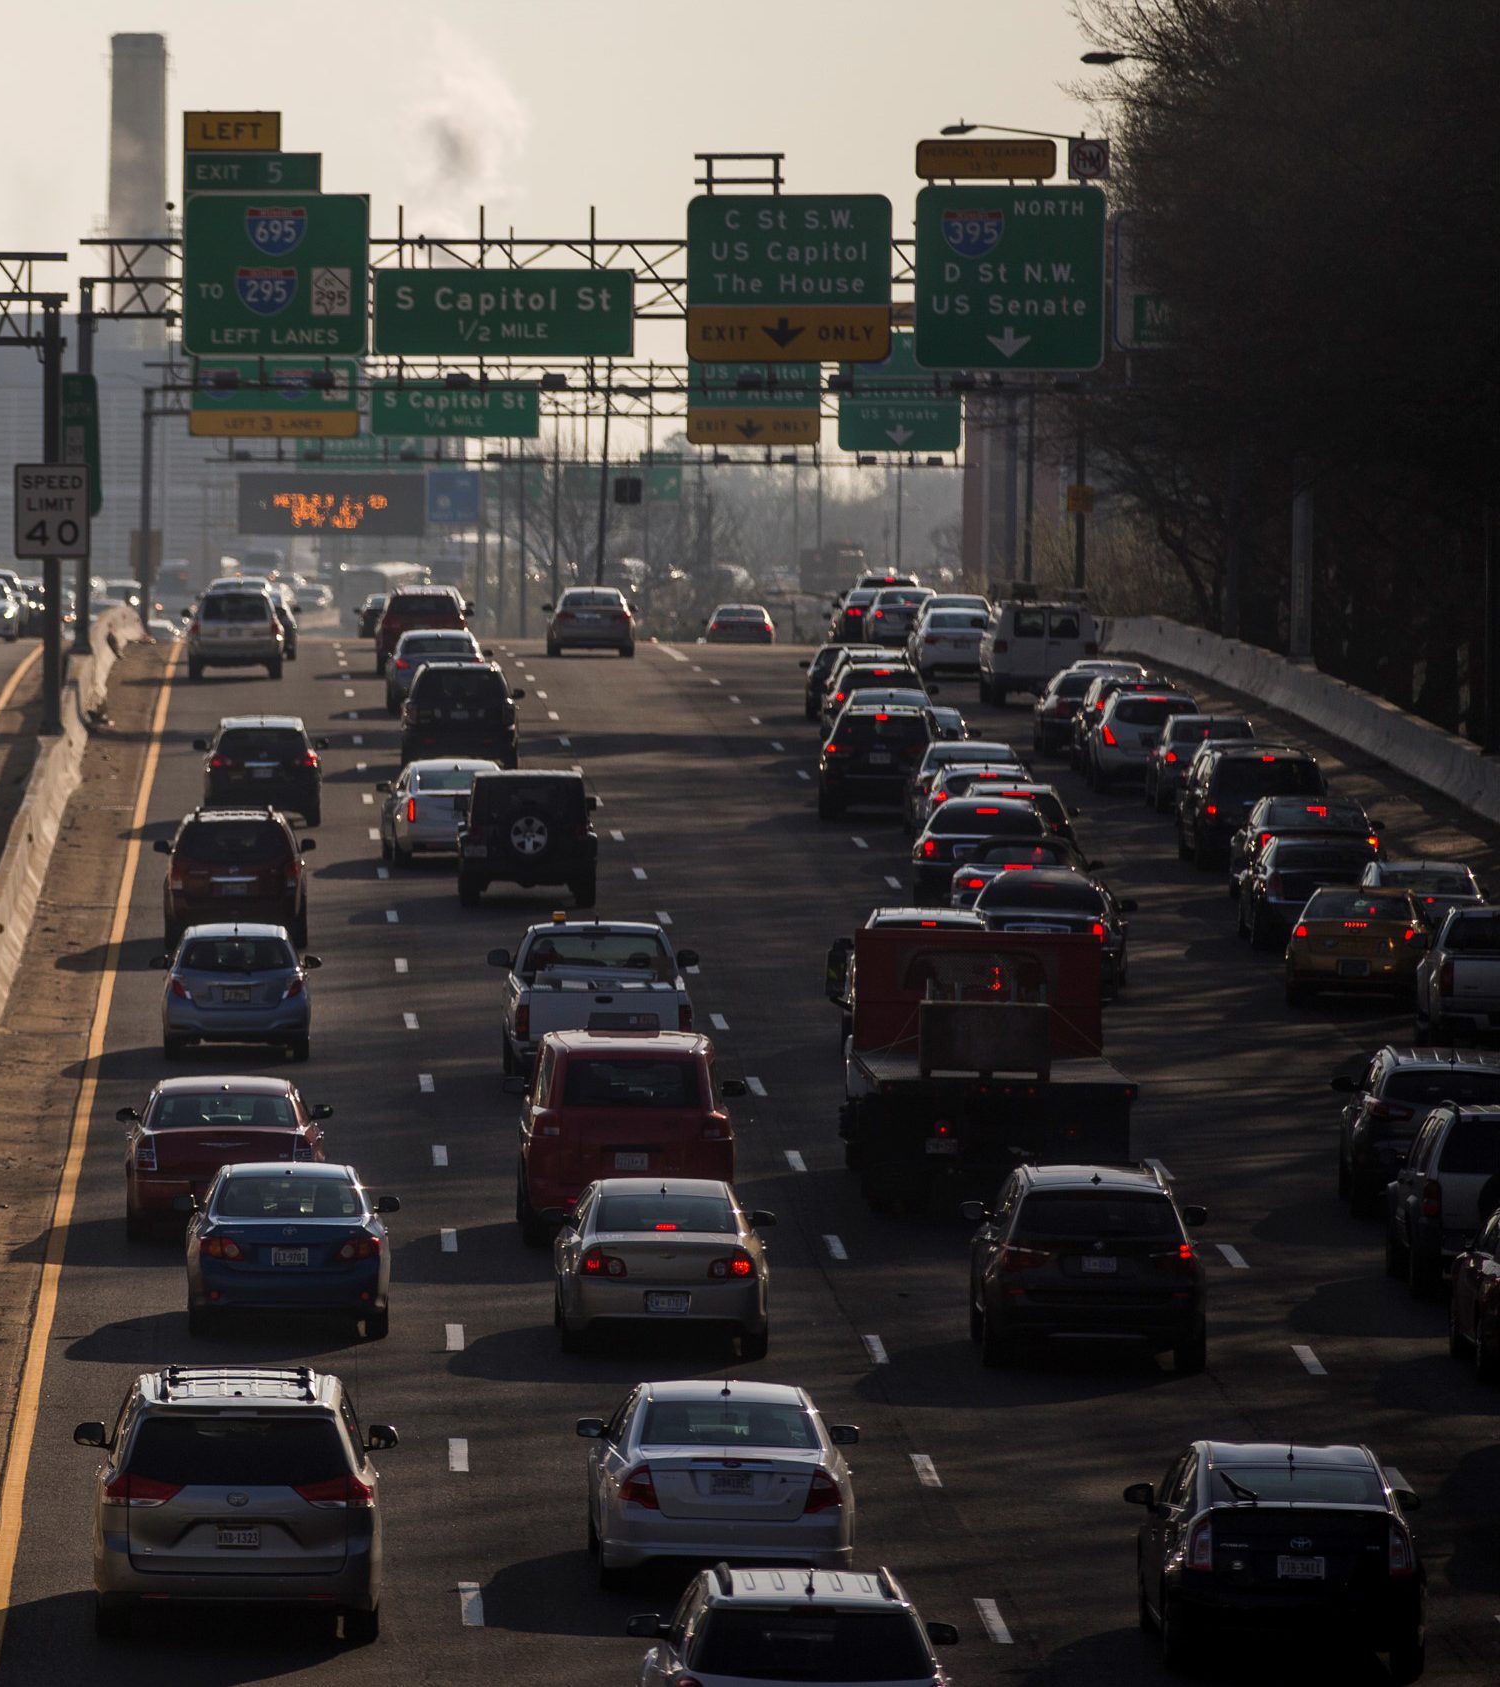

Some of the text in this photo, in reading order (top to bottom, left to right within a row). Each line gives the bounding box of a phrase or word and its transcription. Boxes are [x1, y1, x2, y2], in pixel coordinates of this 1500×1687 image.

[202, 121, 262, 140] LEFT
[195, 160, 283, 184] EXIT 5
[1013, 200, 1084, 217] NORTH
[724, 209, 854, 230] C St S.W.
[255, 219, 297, 244] 695
[949, 221, 998, 245] 395
[711, 240, 867, 266] US Capitol
[944, 262, 1075, 284] D St N.W.
[198, 279, 288, 303] TO 295
[713, 273, 866, 294] The House
[314, 290, 348, 307] 295
[395, 286, 612, 316] S Capitol St
[931, 294, 1087, 316] US Senate
[210, 327, 340, 345] LEFT LANES
[501, 322, 549, 340] MILE
[701, 325, 875, 342] EXIT ONLY
[704, 365, 729, 380] US
[383, 390, 527, 413] S Capitol St
[224, 416, 256, 430] LEFT
[260, 415, 273, 432] 3
[452, 415, 485, 428] MILE
[860, 407, 939, 421] US Senate
[21, 475, 84, 490] SPEED
[27, 497, 75, 512] LIMIT
[25, 519, 79, 547] 40
